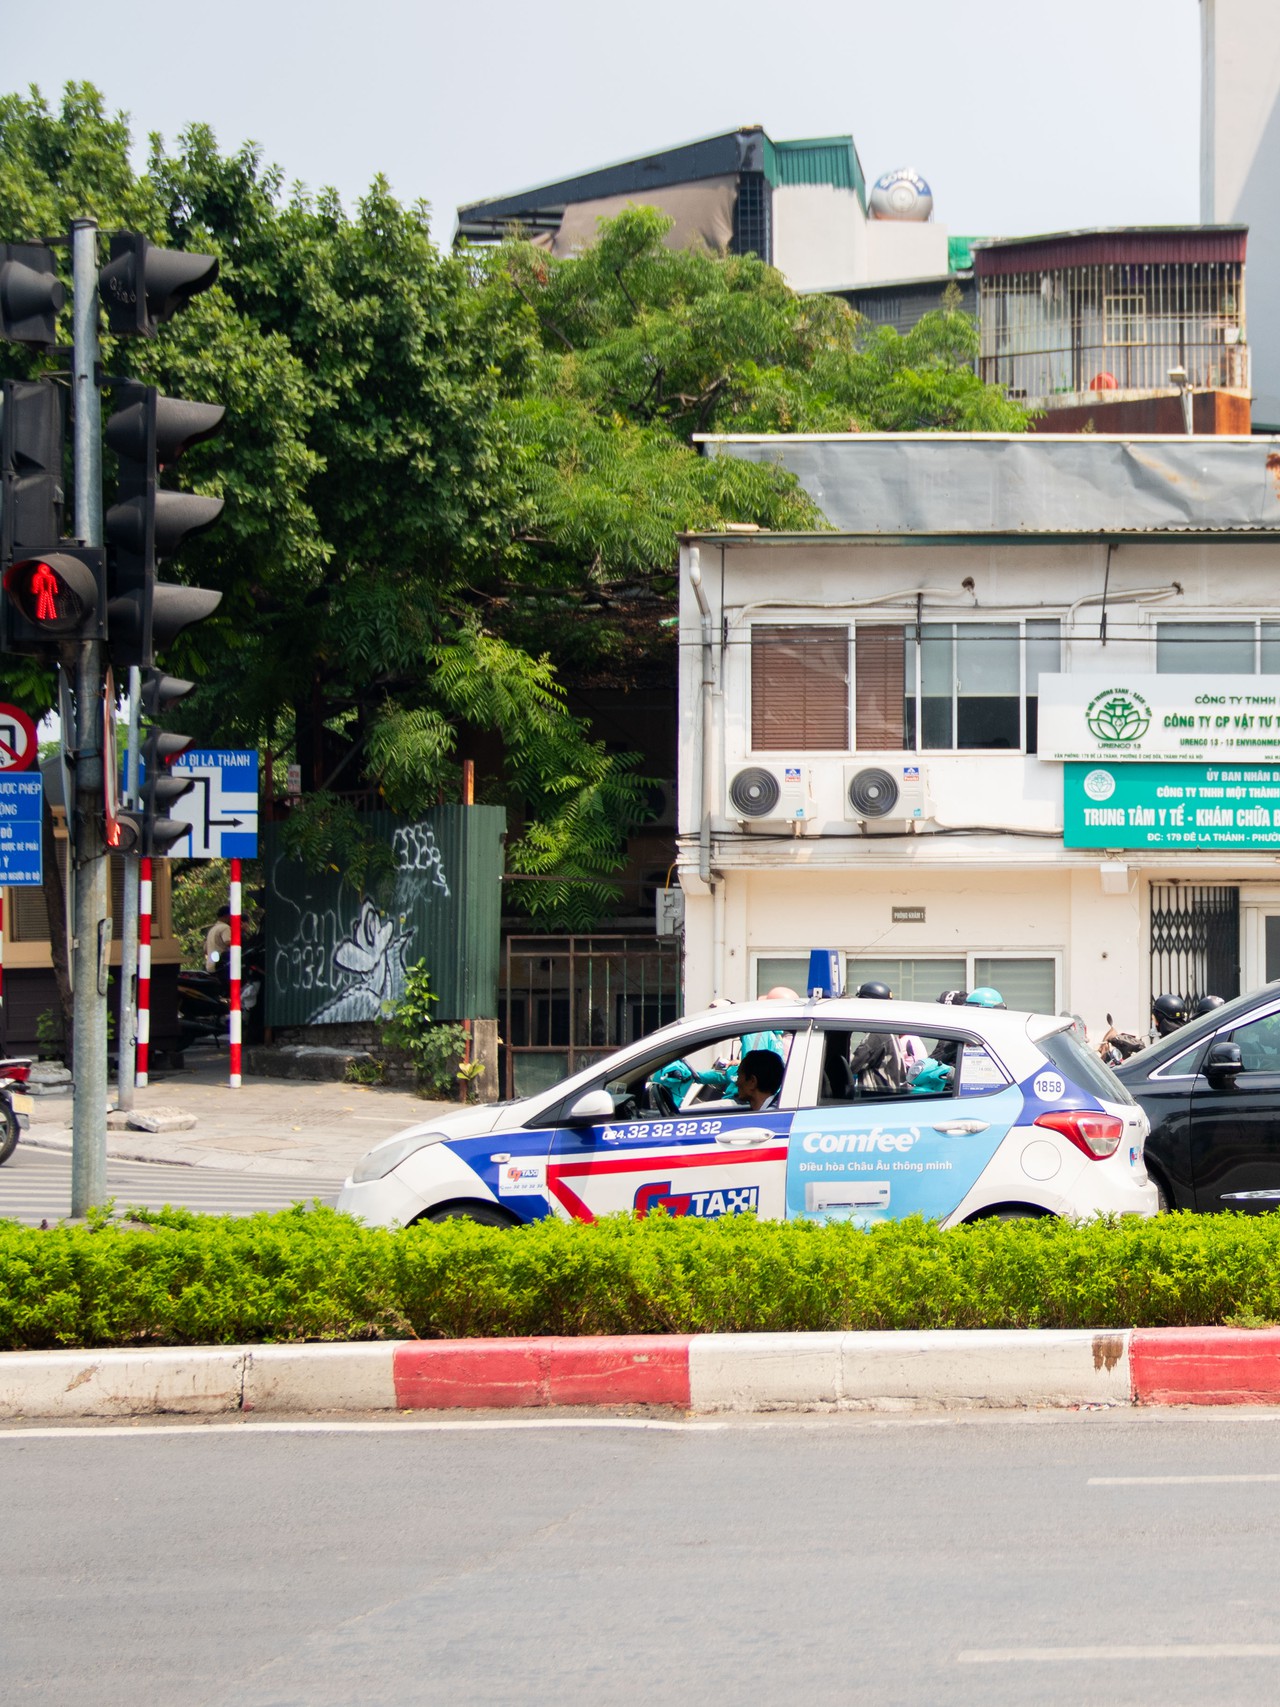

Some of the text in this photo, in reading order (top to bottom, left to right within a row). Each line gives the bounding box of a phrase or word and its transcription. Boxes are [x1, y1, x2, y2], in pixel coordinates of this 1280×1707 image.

[1195, 694, 1226, 704] CÔNG
[1245, 697, 1276, 705] TNHH
[1164, 713, 1195, 728] CÔNG
[1199, 716, 1211, 728] TY
[1215, 716, 1230, 728] CP
[1234, 713, 1255, 731] VẬT
[1258, 714, 1273, 728] TƯ
[1180, 738, 1208, 746] URENCO
[189, 752, 250, 767] ĐI LA THÀNH
[1206, 768, 1220, 781] ỦY
[1221, 772, 1242, 782] BAN
[1243, 770, 1271, 782] NHÂN
[0, 783, 18, 796] ƯỢC
[1156, 785, 1183, 798] CÔNG
[1185, 787, 1197, 798] TY
[1198, 787, 1224, 798] TNHH
[1225, 786, 1247, 800] MỘT
[1249, 786, 1280, 798] THÀNH
[1083, 808, 1126, 826] TRUNG
[1128, 805, 1155, 826] TÂM
[1158, 809, 1167, 826] Y
[1169, 803, 1186, 827] TẾ
[1196, 806, 1234, 827] KHÁM
[1236, 805, 1271, 827] CHỮA
[1147, 833, 1164, 842] ĐC:
[1166, 833, 1182, 842] 179
[1183, 832, 1197, 842] ĐÊ
[1198, 834, 1212, 842] LA
[1213, 832, 1245, 842] THÀNH
[1035, 1080, 1062, 1093] 1858
[651, 1123, 674, 1137] 32
[675, 1122, 698, 1136] 32
[700, 1121, 722, 1135] 32
[799, 1160, 953, 1173] Điều hòa Châu Âu thông minh
[691, 1188, 758, 1216] TAXI
